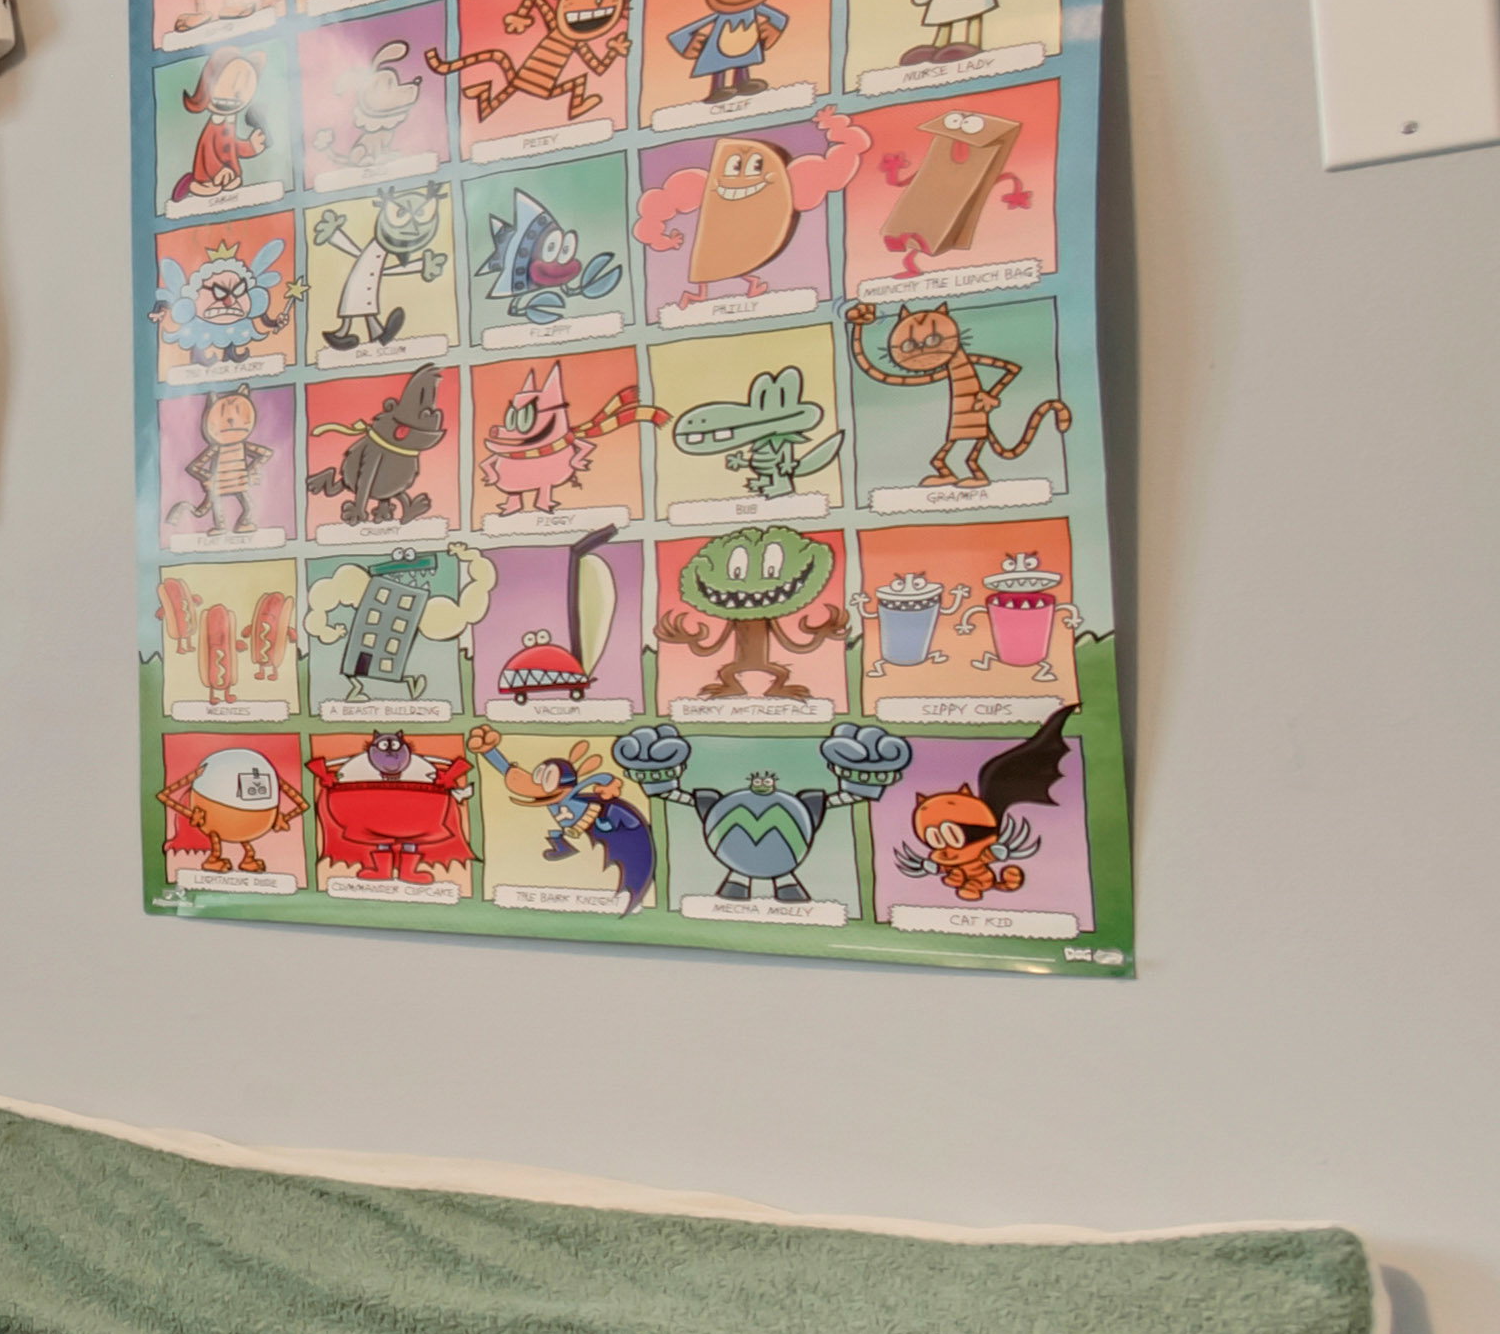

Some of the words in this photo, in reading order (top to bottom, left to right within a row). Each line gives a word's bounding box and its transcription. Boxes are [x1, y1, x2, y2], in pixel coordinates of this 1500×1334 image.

[902, 65, 948, 84] NURSE
[957, 57, 997, 74] LADY
[522, 133, 560, 150] PETEY
[863, 279, 920, 298] MUNCHY
[925, 275, 949, 291] THE
[955, 270, 1001, 288] LUNCH
[1004, 265, 1034, 282] BAG
[712, 300, 759, 316] PHILLY
[926, 488, 989, 504] GRAMPA
[536, 514, 575, 527] PIGGY
[329, 704, 339, 716] A
[385, 704, 440, 717] BUILDING
[682, 704, 723, 717] BARKY
[921, 703, 969, 717] SIPPY
[974, 702, 1013, 716] CUPS
[194, 874, 250, 889] LIGHTNING
[331, 881, 400, 896] COMMANDER
[404, 884, 455, 899] CUPCAKE
[516, 890, 538, 903] THE
[540, 891, 571, 905] BARK
[713, 902, 760, 916] MECHA
[767, 903, 814, 918] MOLLY
[949, 914, 979, 926] CAT
[984, 915, 1014, 929] KID
